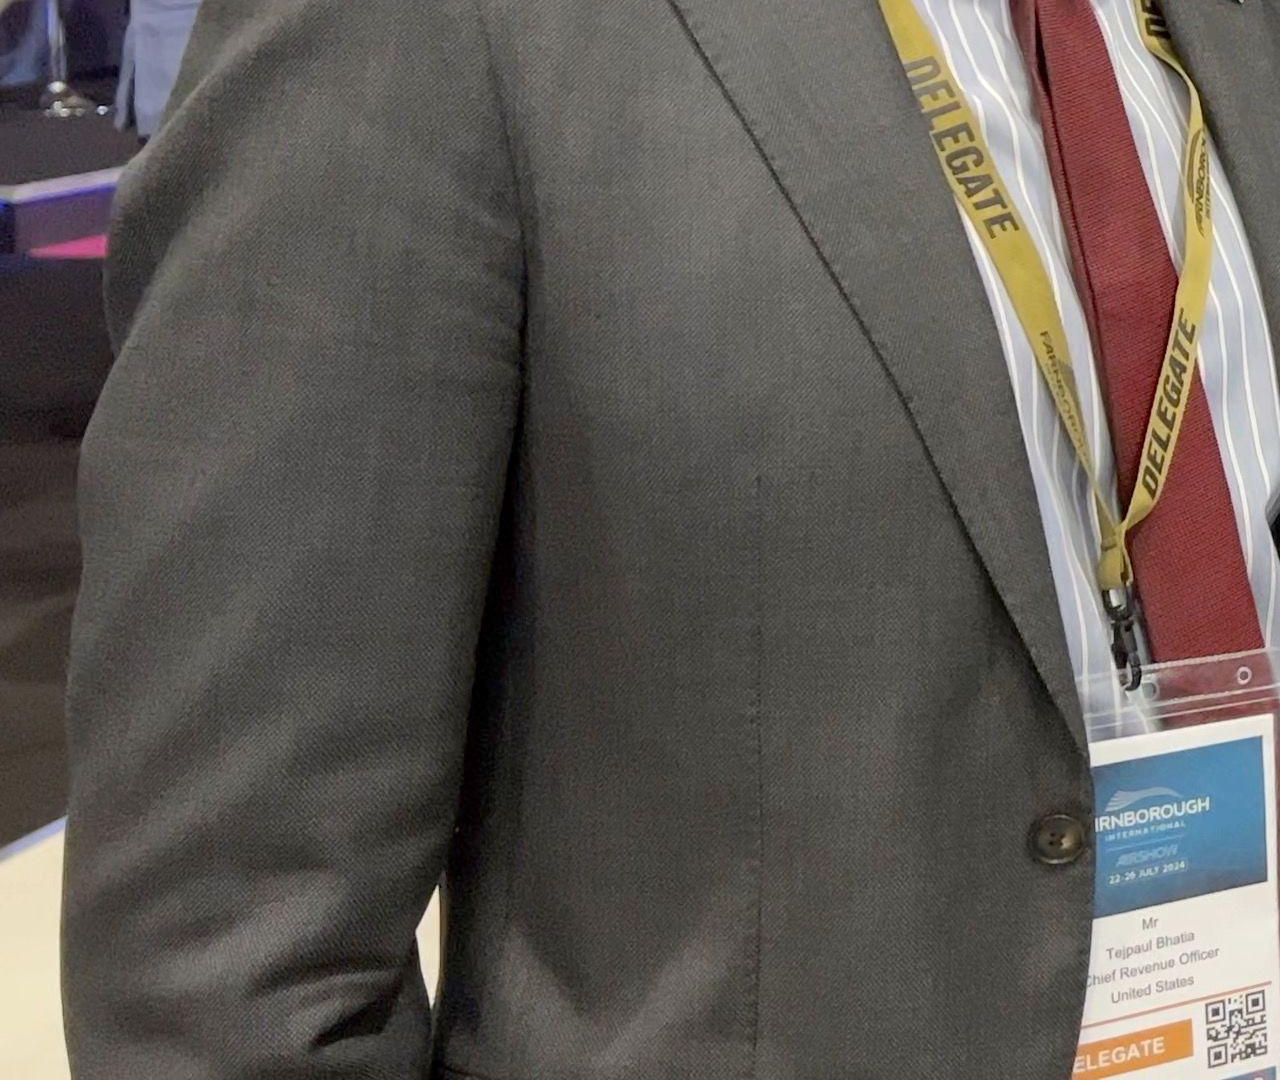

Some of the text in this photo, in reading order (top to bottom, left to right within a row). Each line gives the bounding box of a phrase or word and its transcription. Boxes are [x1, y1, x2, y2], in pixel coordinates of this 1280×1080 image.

[1142, 308, 1197, 500] DELEGATE
[1105, 820, 1186, 841] INTERNATIONAL
[1142, 917, 1159, 930] Mr
[1106, 931, 1195, 960] Tejpaul Bhatia
[1120, 958, 1175, 980] Revenue
[1179, 947, 1219, 965] Officer
[1111, 975, 1195, 1004] United States
[1075, 1036, 1166, 1072] ELEGATE
